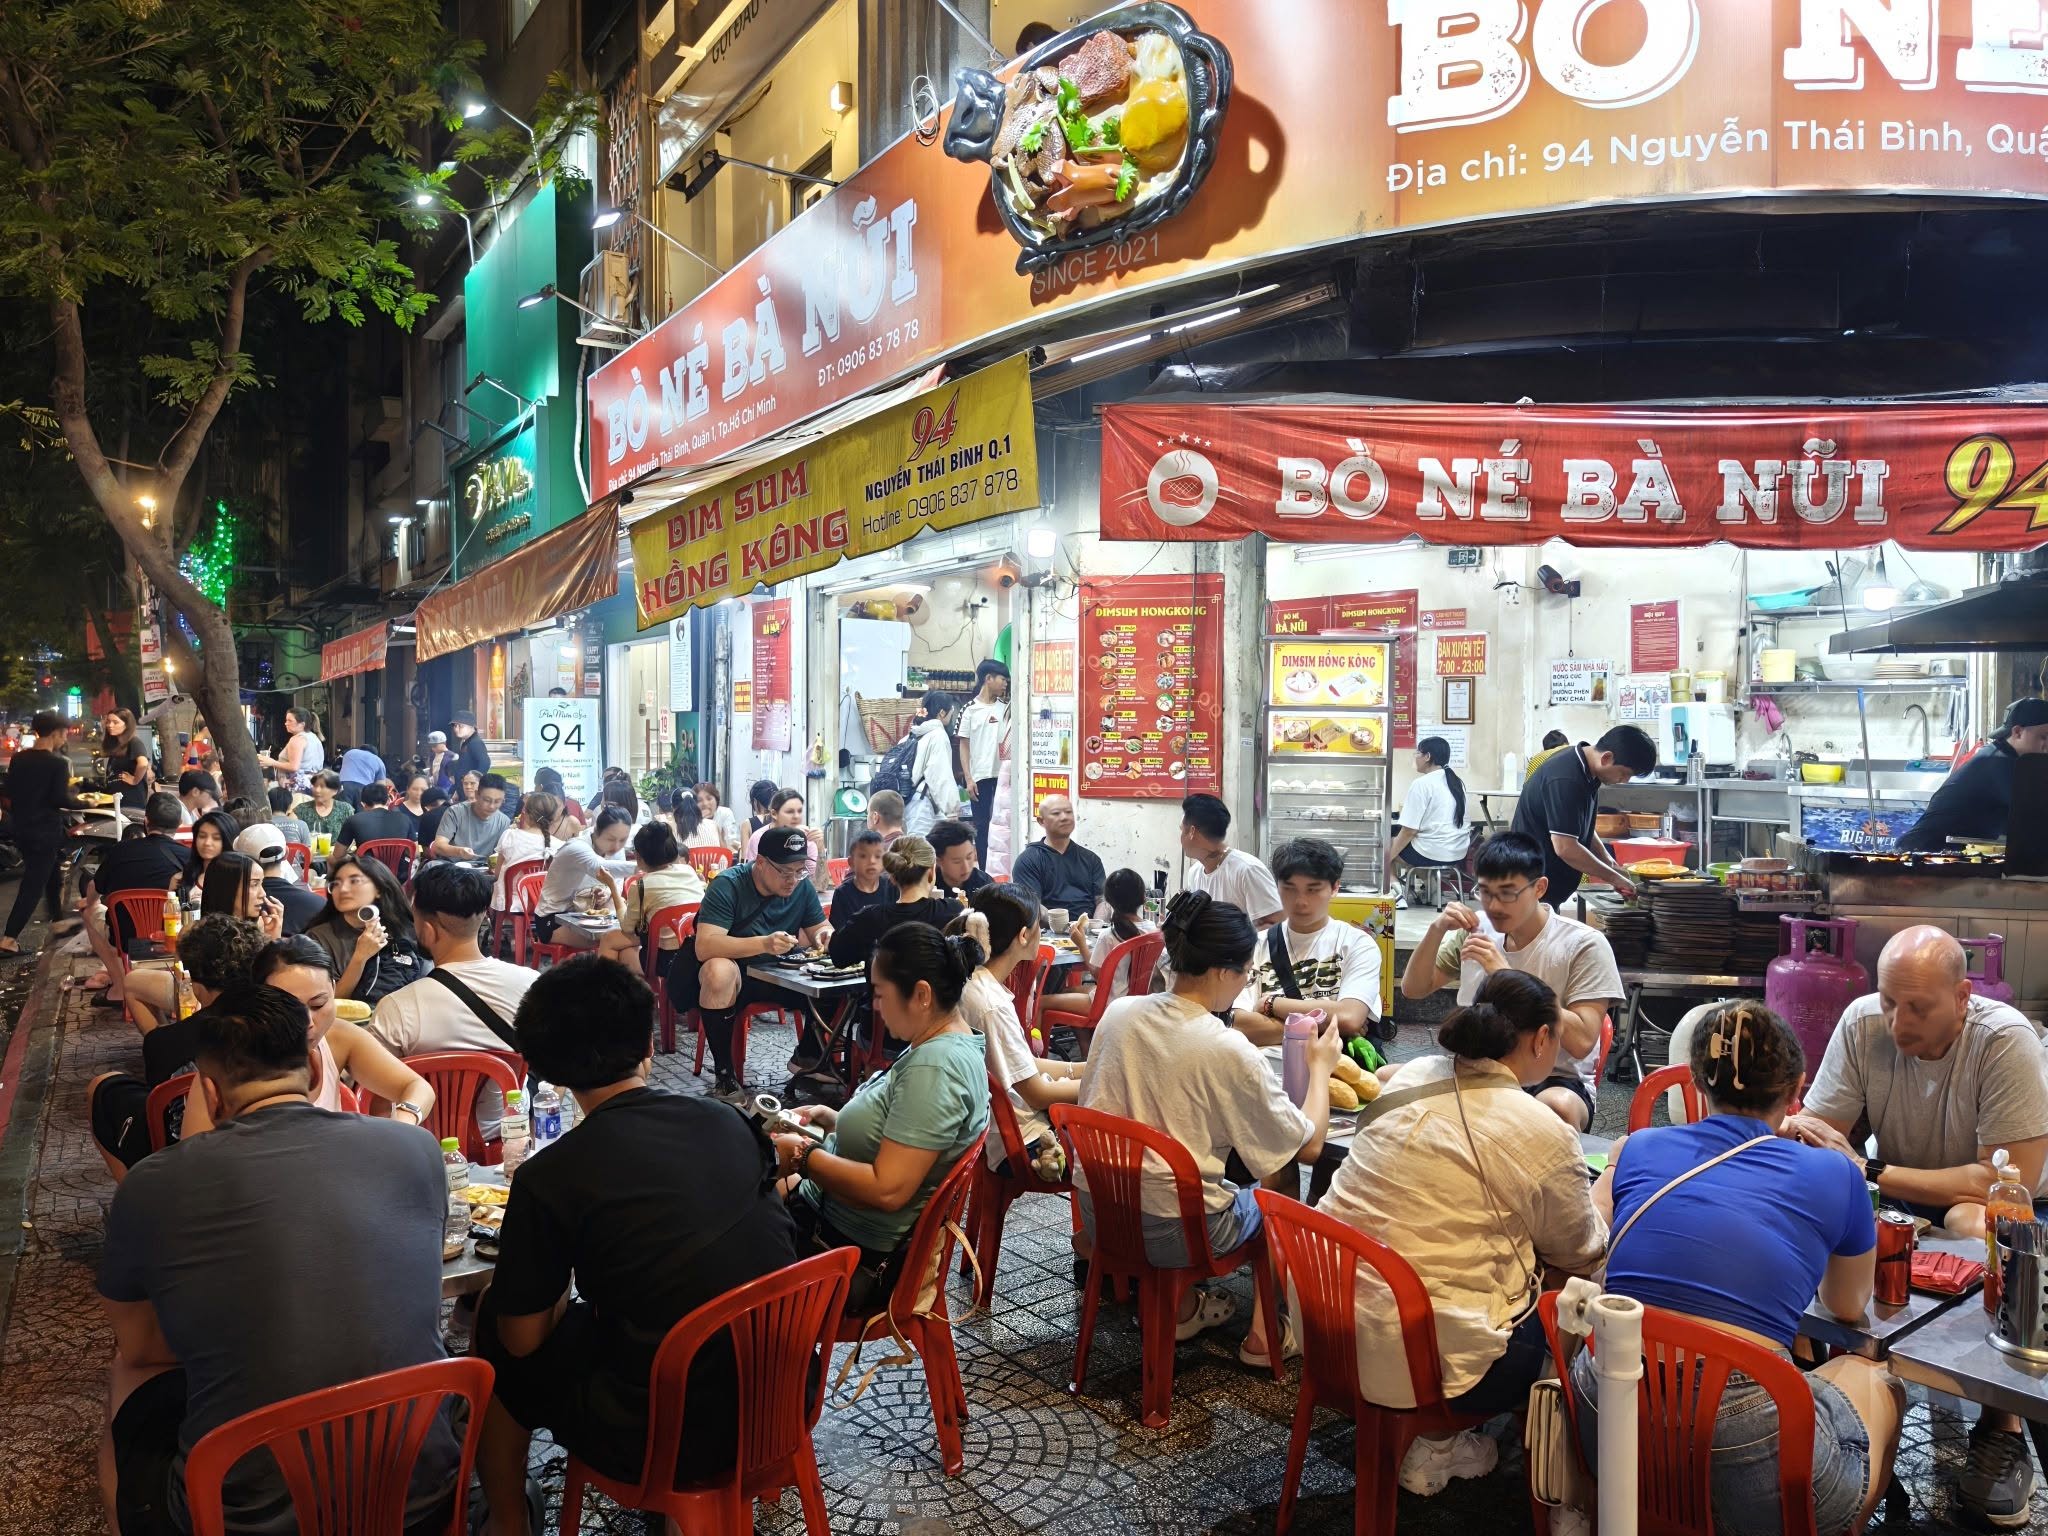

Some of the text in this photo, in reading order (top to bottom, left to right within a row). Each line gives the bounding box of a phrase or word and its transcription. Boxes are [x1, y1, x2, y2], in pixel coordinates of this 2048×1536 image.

[1386, 160, 1447, 195] Địa
[1460, 144, 1528, 183] chỉ:
[1542, 142, 1593, 172] 94
[1609, 116, 1768, 168] Nguyễn
[1783, 119, 1865, 152] Thái
[1880, 119, 1972, 157] Bình,
[1033, 232, 1158, 295] SINCE 2021
[606, 367, 649, 466] BÒ
[658, 321, 710, 437] NÉ
[720, 273, 787, 402] BÀ
[818, 319, 919, 388] ĐT: 0906 83 78 78
[660, 449, 673, 465] Thái
[693, 430, 711, 451] Quận
[757, 398, 776, 422] Minh
[907, 387, 961, 462] 94
[733, 459, 810, 523] SUM
[864, 434, 1012, 502] NGUYỄN THÁI BÌNH Q.1
[1275, 434, 2048, 535] BÒ NÉ BÀ NŨI 94
[862, 468, 1019, 537] Hotline: 0906 837 878
[642, 507, 850, 615] HỒNG KÔNG
[1096, 606, 1207, 617] DIMSUM HONGKONG
[1275, 622, 1288, 633] BÀ
[1342, 606, 1407, 618] DIMSUM HONGKONG
[1438, 637, 1485, 657] BÁN XUYÊN TẾT
[1439, 660, 1455, 673] 7:00
[1462, 660, 1484, 673] 23:00
[540, 723, 585, 752] 94
[1840, 830, 1865, 843] BIG
